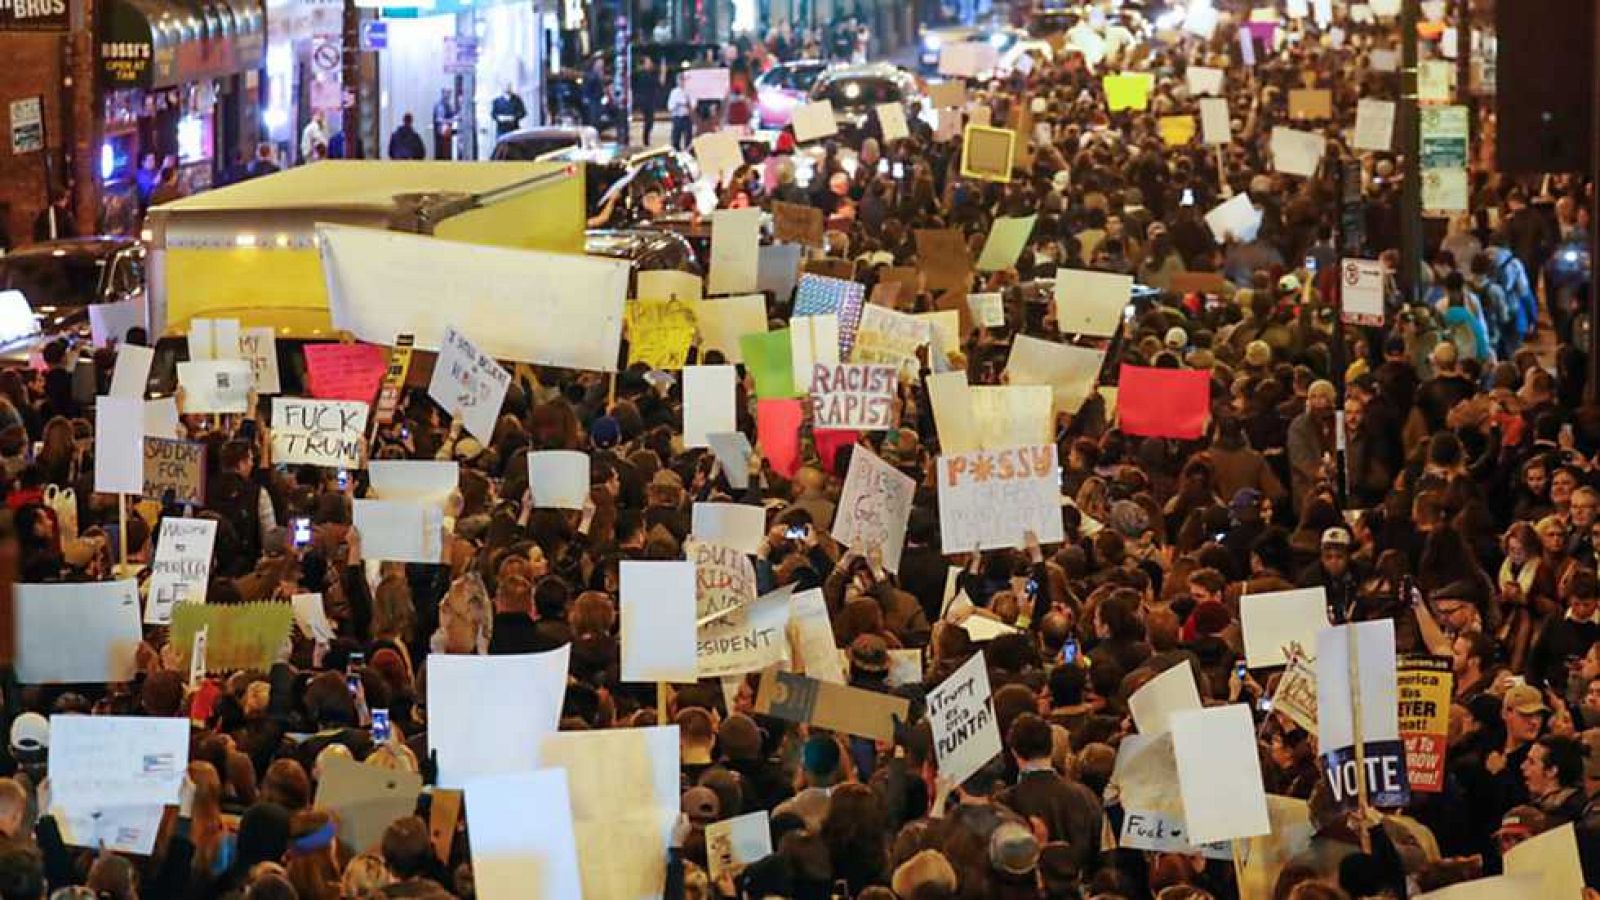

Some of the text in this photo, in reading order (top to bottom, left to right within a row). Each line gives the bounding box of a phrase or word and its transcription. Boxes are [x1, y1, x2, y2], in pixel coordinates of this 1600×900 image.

[14, 0, 65, 18] BROS
[809, 363, 896, 393] RACIST
[284, 403, 358, 435] FUCK
[812, 394, 891, 425] RAPIST
[159, 462, 188, 478] FOR
[697, 626, 776, 656] ESIDENT
[1398, 674, 1440, 687] erica
[1398, 701, 1437, 718] EVER
[1407, 753, 1440, 769] ROW
[1326, 755, 1402, 802] VOTE
